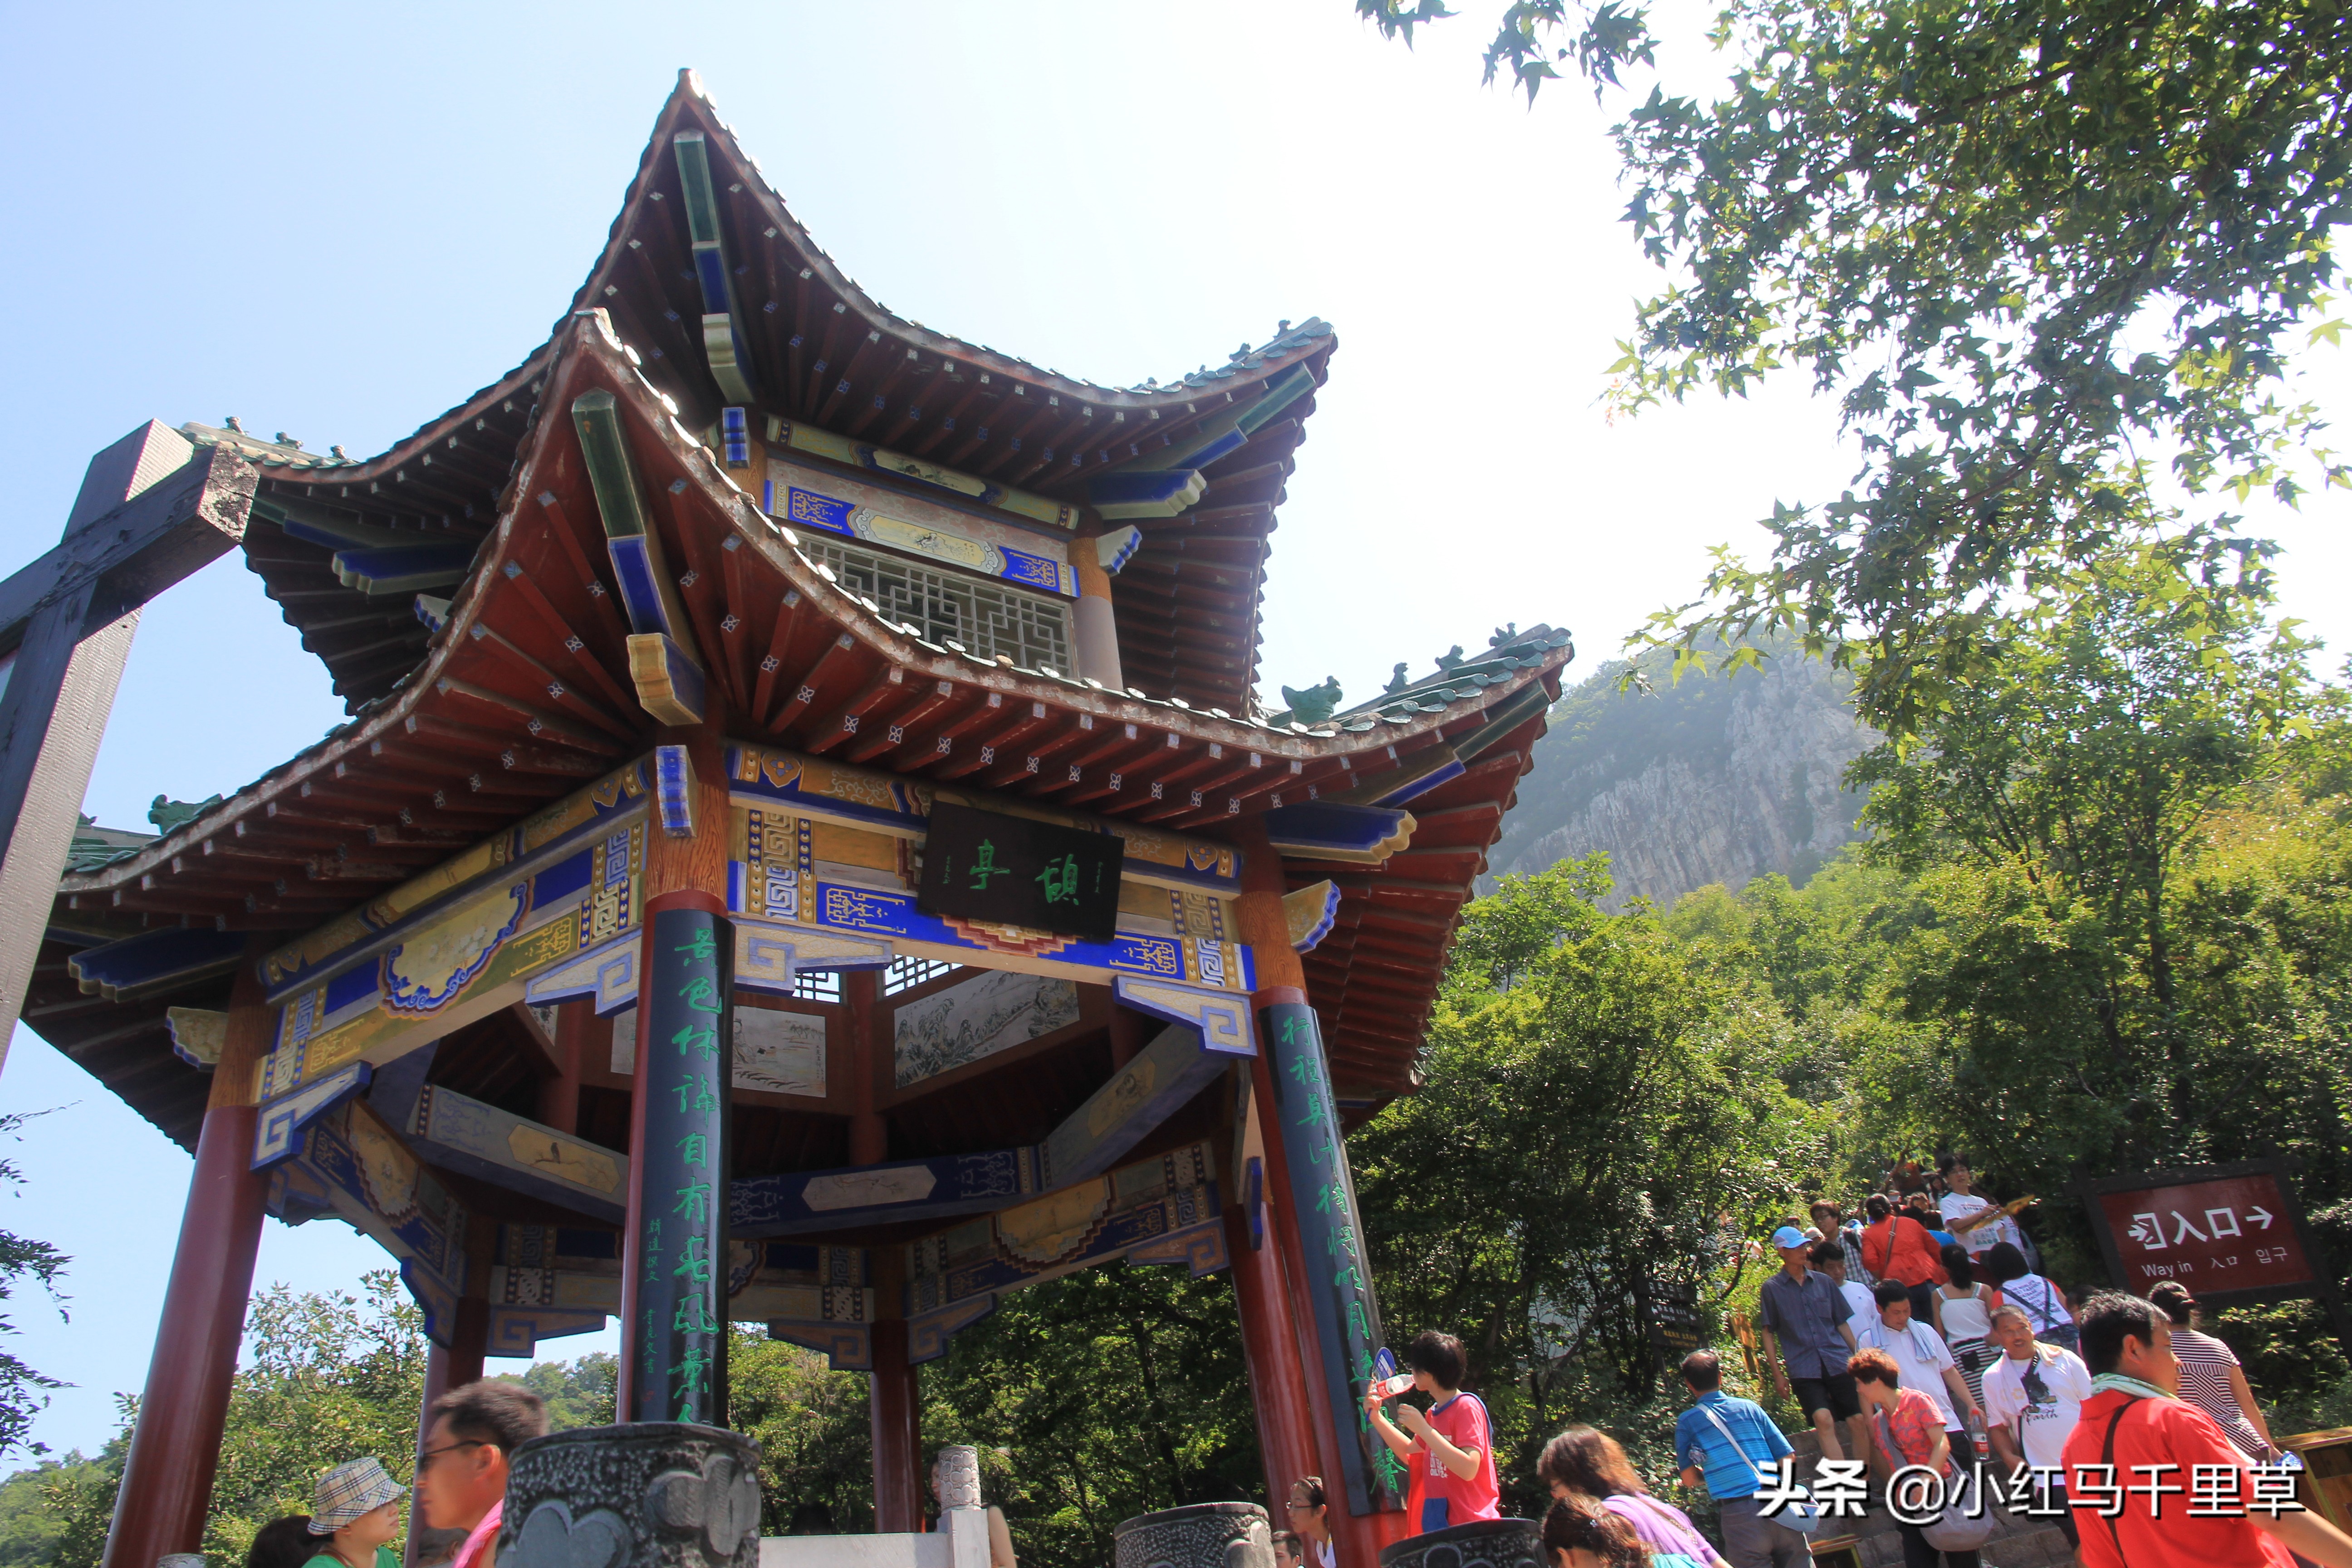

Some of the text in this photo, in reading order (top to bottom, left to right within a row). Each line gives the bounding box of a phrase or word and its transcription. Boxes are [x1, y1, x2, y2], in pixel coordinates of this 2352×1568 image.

[2171, 1207, 2243, 1245] 入口
[2210, 1255, 2238, 1269] 入口
[2255, 1246, 2288, 1264] 입구
[2141, 1261, 2193, 1278] Way in
